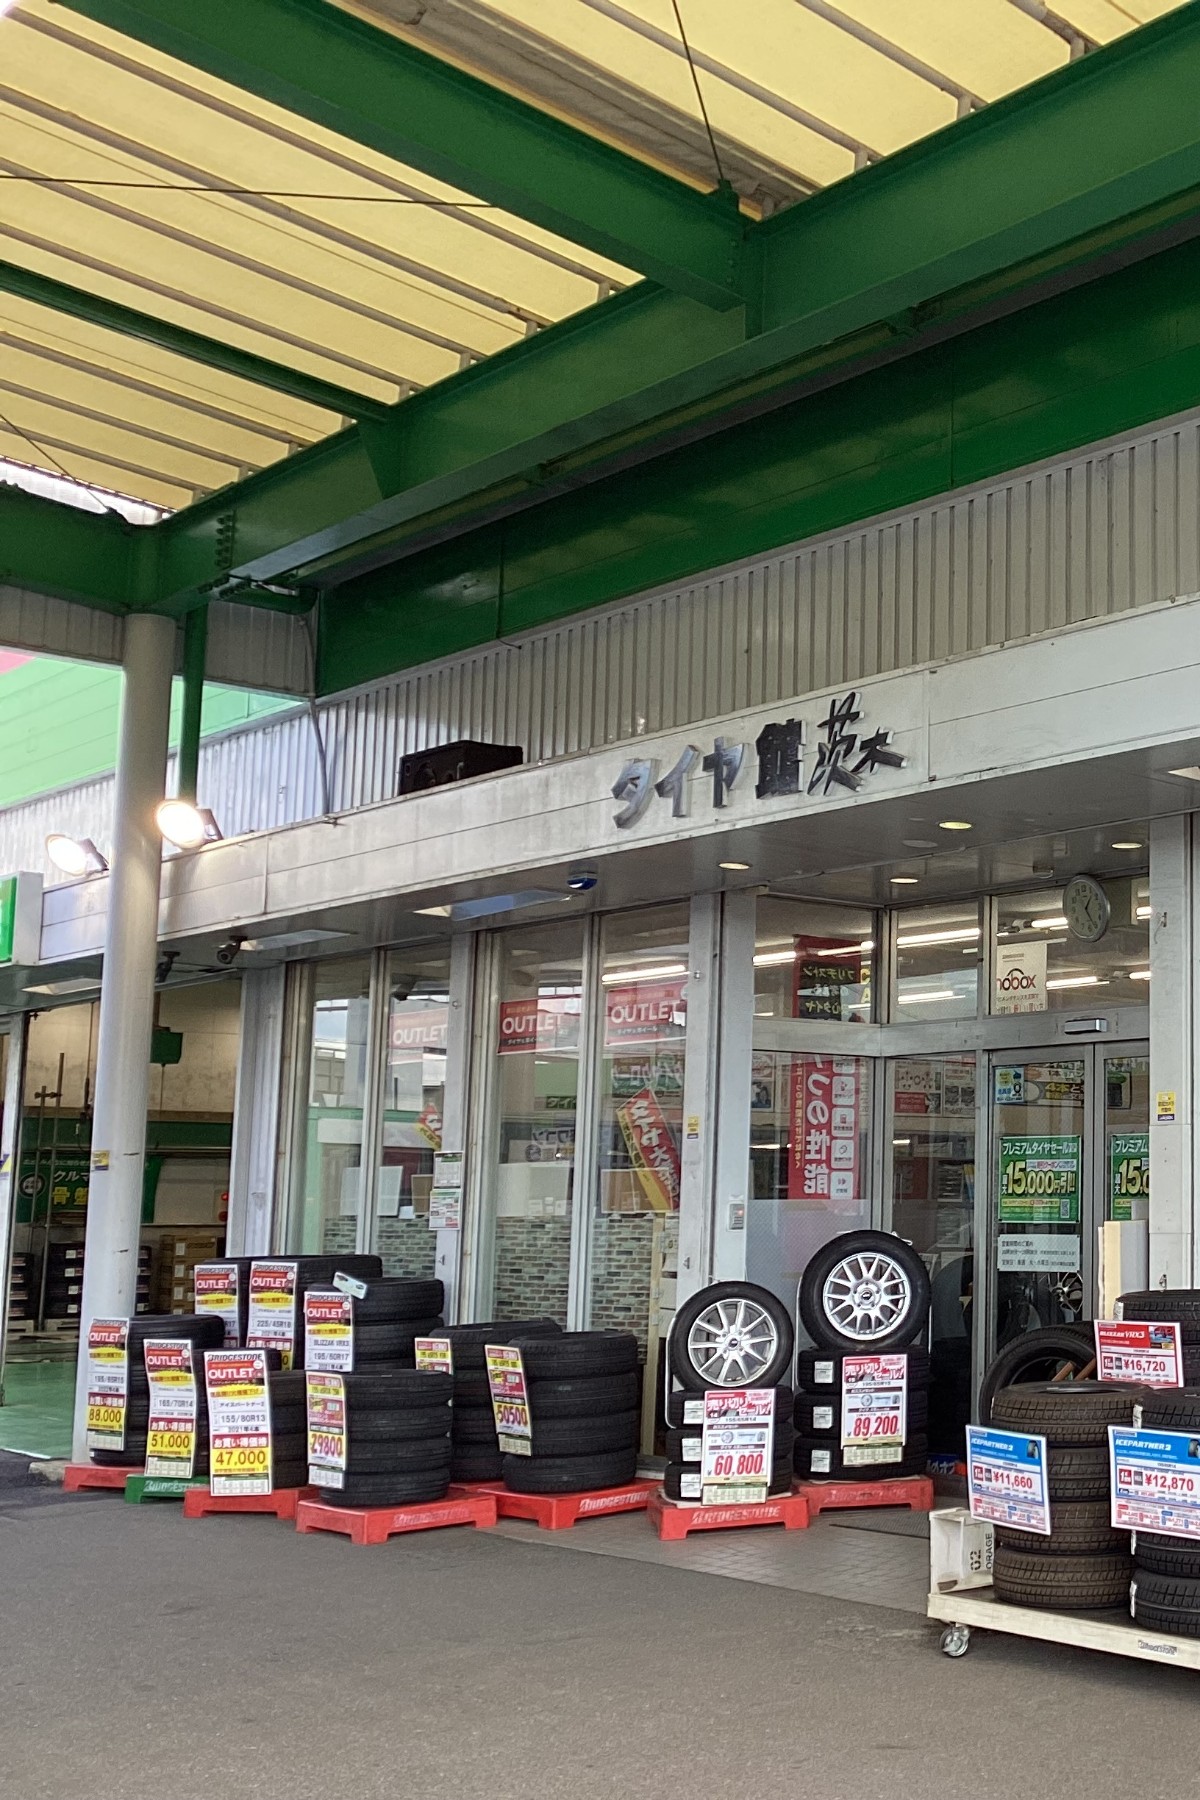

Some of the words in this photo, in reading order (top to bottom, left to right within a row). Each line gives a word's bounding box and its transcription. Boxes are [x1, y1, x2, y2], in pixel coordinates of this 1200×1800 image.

[502, 1013, 564, 1035] OUTLET
[393, 1023, 448, 1044] OUTLET
[196, 1280, 229, 1289] OUTLET
[252, 1278, 287, 1287] OUTLET
[307, 1309, 343, 1317] OUTLET
[89, 1332, 120, 1342] OUTLET
[147, 1356, 183, 1366] OUTLET
[208, 1368, 254, 1379] OUTLET
[854, 1415, 898, 1437] 89,200
[151, 1435, 190, 1449] 51,000
[216, 1450, 266, 1466] 47,000
[714, 1453, 764, 1476] 60,800
[993, 1471, 1033, 1489] ¥11,660
[1145, 1473, 1195, 1492] ¥12,870
